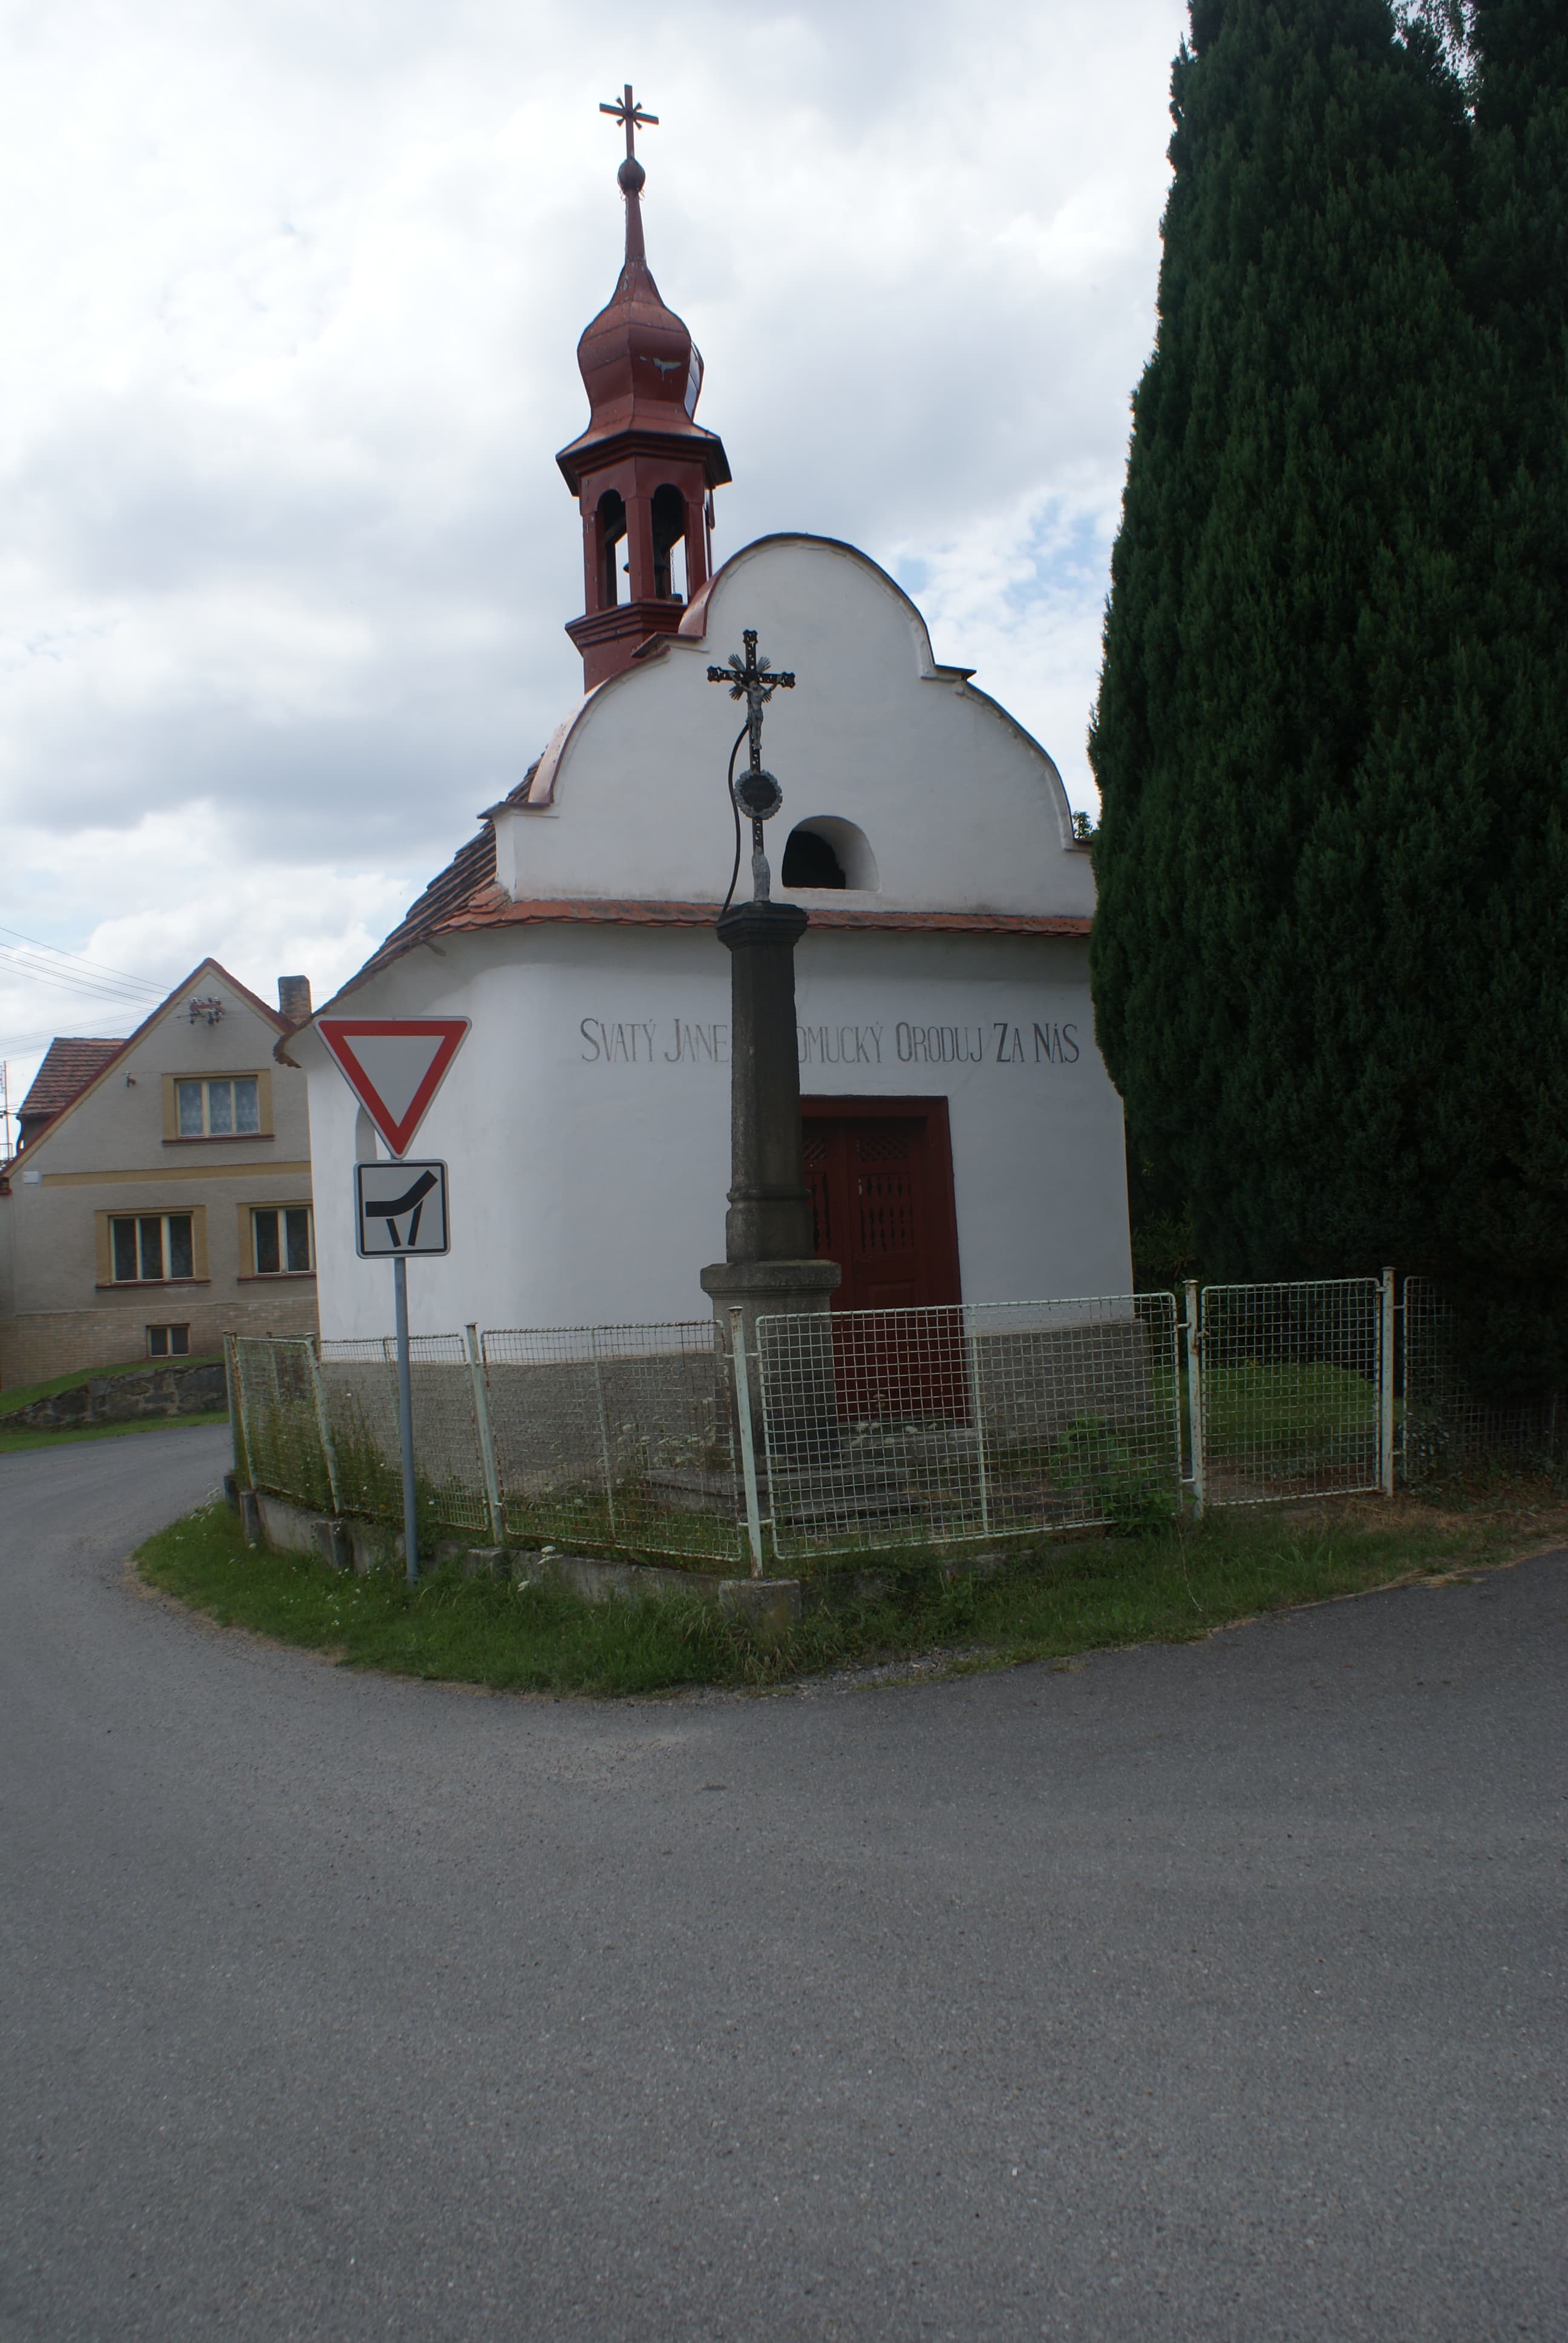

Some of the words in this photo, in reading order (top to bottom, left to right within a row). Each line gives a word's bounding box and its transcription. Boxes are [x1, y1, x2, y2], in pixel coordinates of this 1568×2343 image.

[580, 1018, 656, 1062] SVATÝ
[664, 1018, 730, 1062] JANE
[895, 1022, 982, 1063] ORODUJ
[993, 1023, 1025, 1063] ZA
[1031, 1023, 1080, 1063] NÁS
